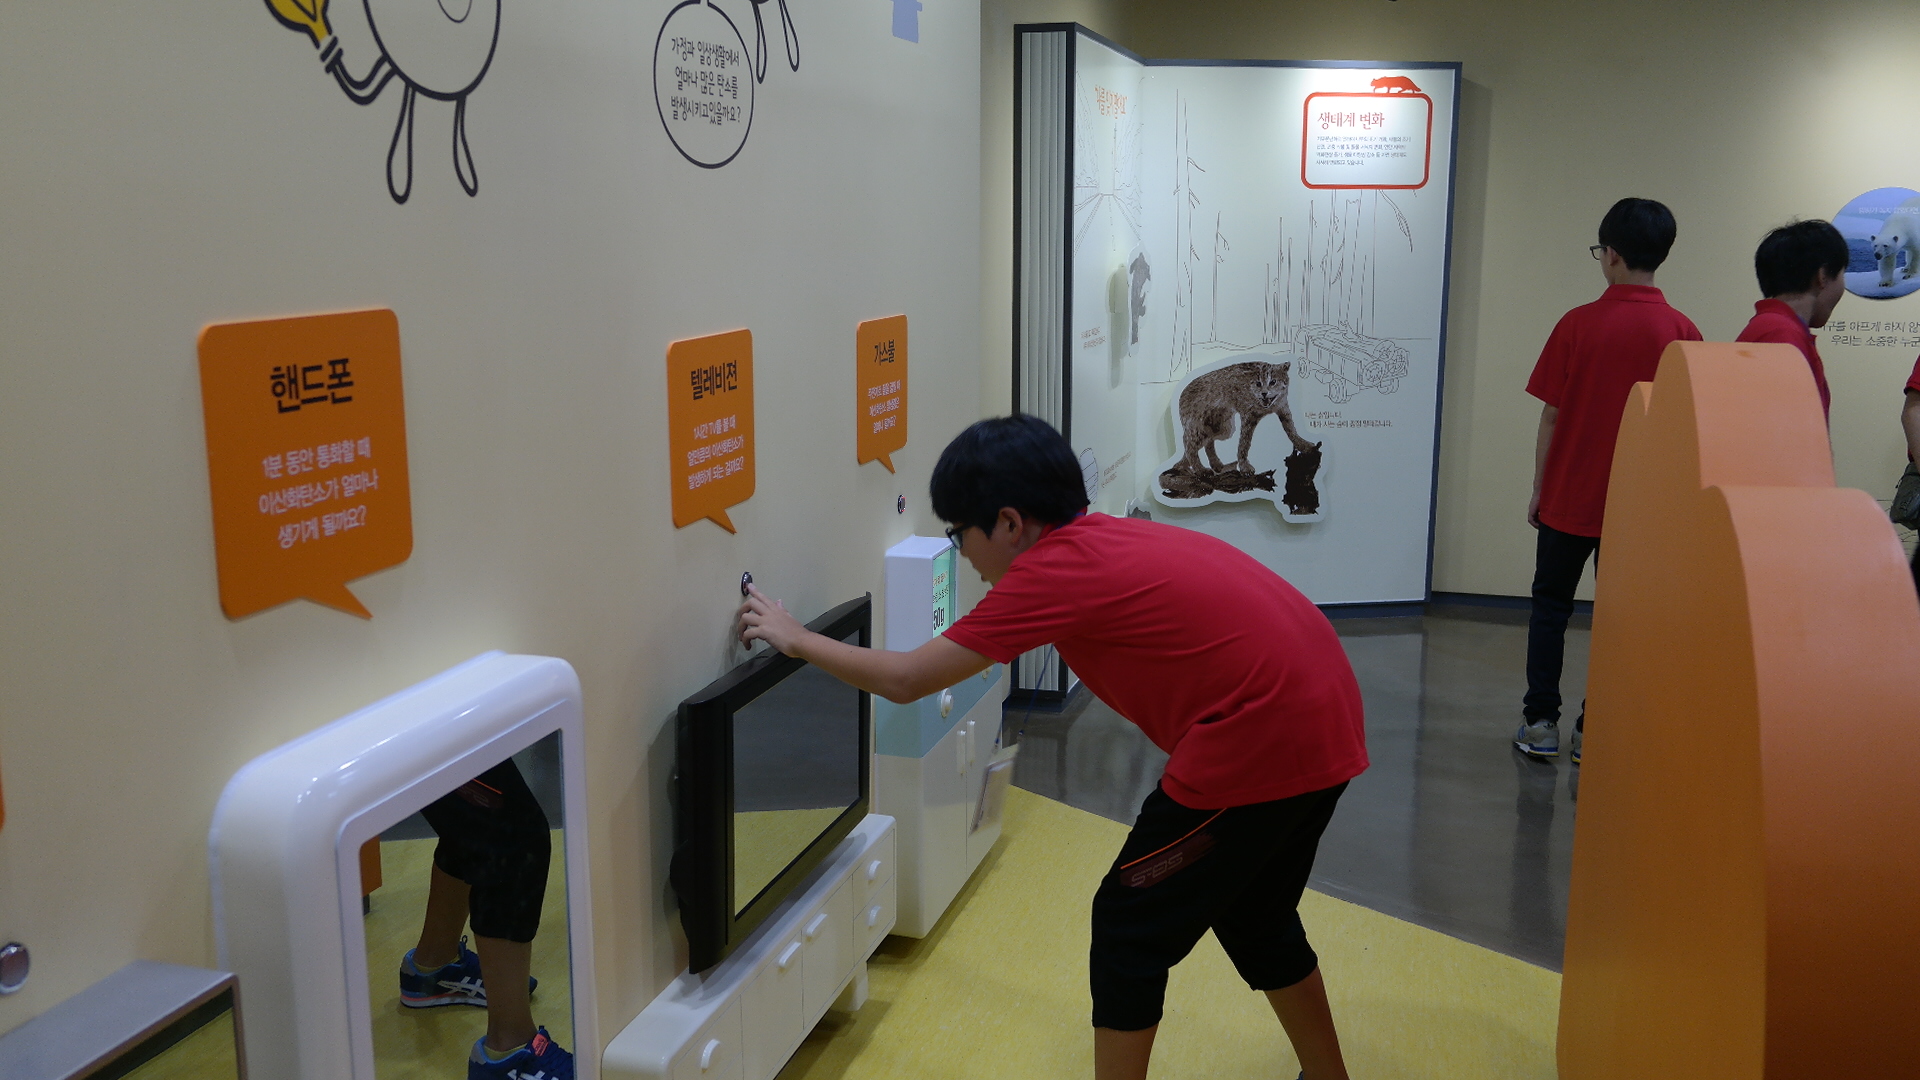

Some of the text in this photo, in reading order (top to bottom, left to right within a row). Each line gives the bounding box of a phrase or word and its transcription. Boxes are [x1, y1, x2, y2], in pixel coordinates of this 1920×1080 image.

[671, 37, 740, 69] 가정과 일상생활에서
[675, 66, 739, 99] 얼마나 많은 탄소를
[1317, 111, 1386, 130] 생태계 변화
[1830, 334, 1863, 347] 우리는
[1864, 335, 1898, 348] 소중한
[1849, 320, 1882, 332] 아프게
[1884, 320, 1906, 333] 하지
[873, 338, 897, 366] 가스불
[270, 357, 355, 414] 핸드폰
[691, 360, 737, 400] 텔레비젼
[261, 436, 372, 480] 1분 동안 통화할 때
[258, 467, 380, 516] 이산화탄소가 얼마나
[277, 504, 368, 549] 생기게 될까요?
[933, 606, 945, 631] 50g
